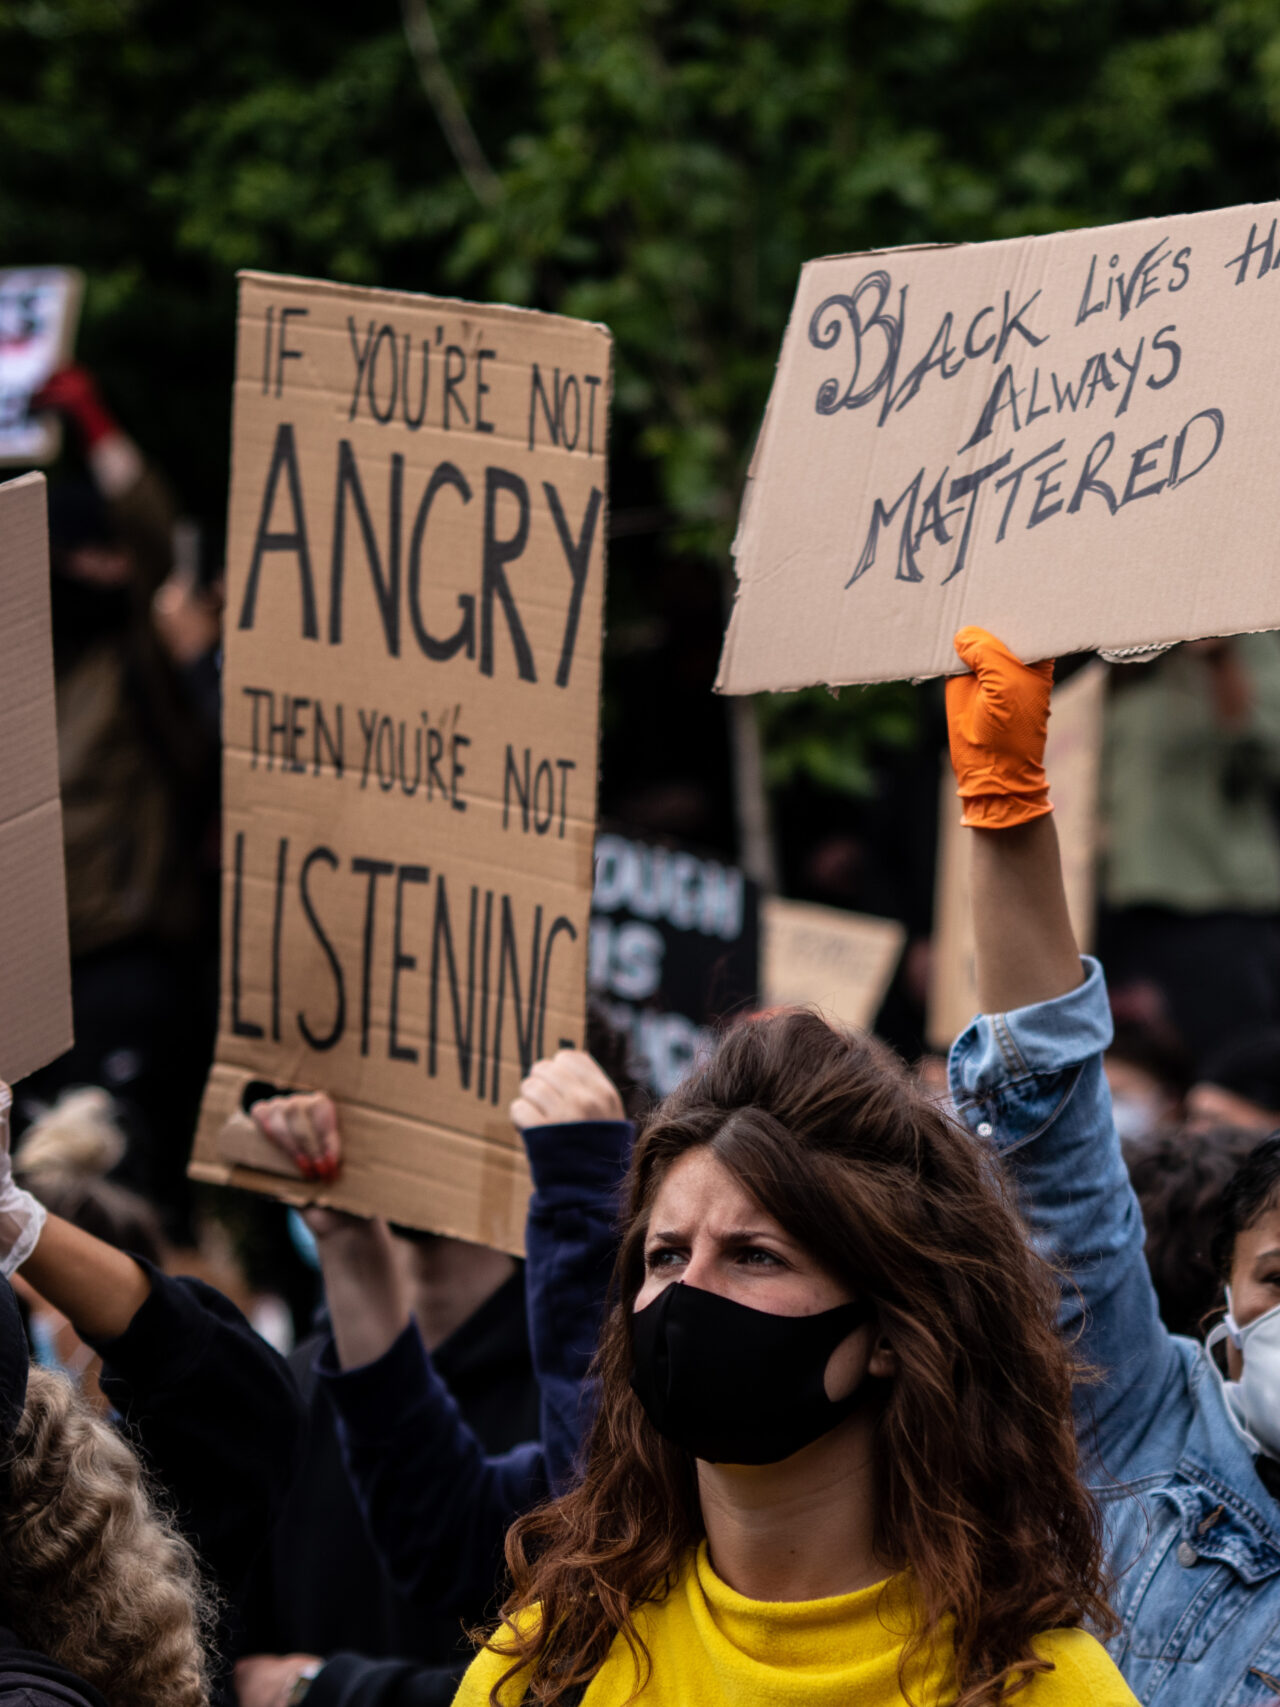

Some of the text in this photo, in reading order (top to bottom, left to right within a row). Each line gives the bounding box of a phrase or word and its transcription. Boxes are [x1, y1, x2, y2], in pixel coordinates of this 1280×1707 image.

[261, 307, 602, 456] IF YOU'RE NOT
[957, 324, 1182, 455] ALWAYS
[237, 423, 604, 688] ANGRY
[844, 407, 1226, 590] MATTERED
[242, 686, 576, 840] THEN YOU'RE NOT
[230, 831, 577, 1106] LISTENING
